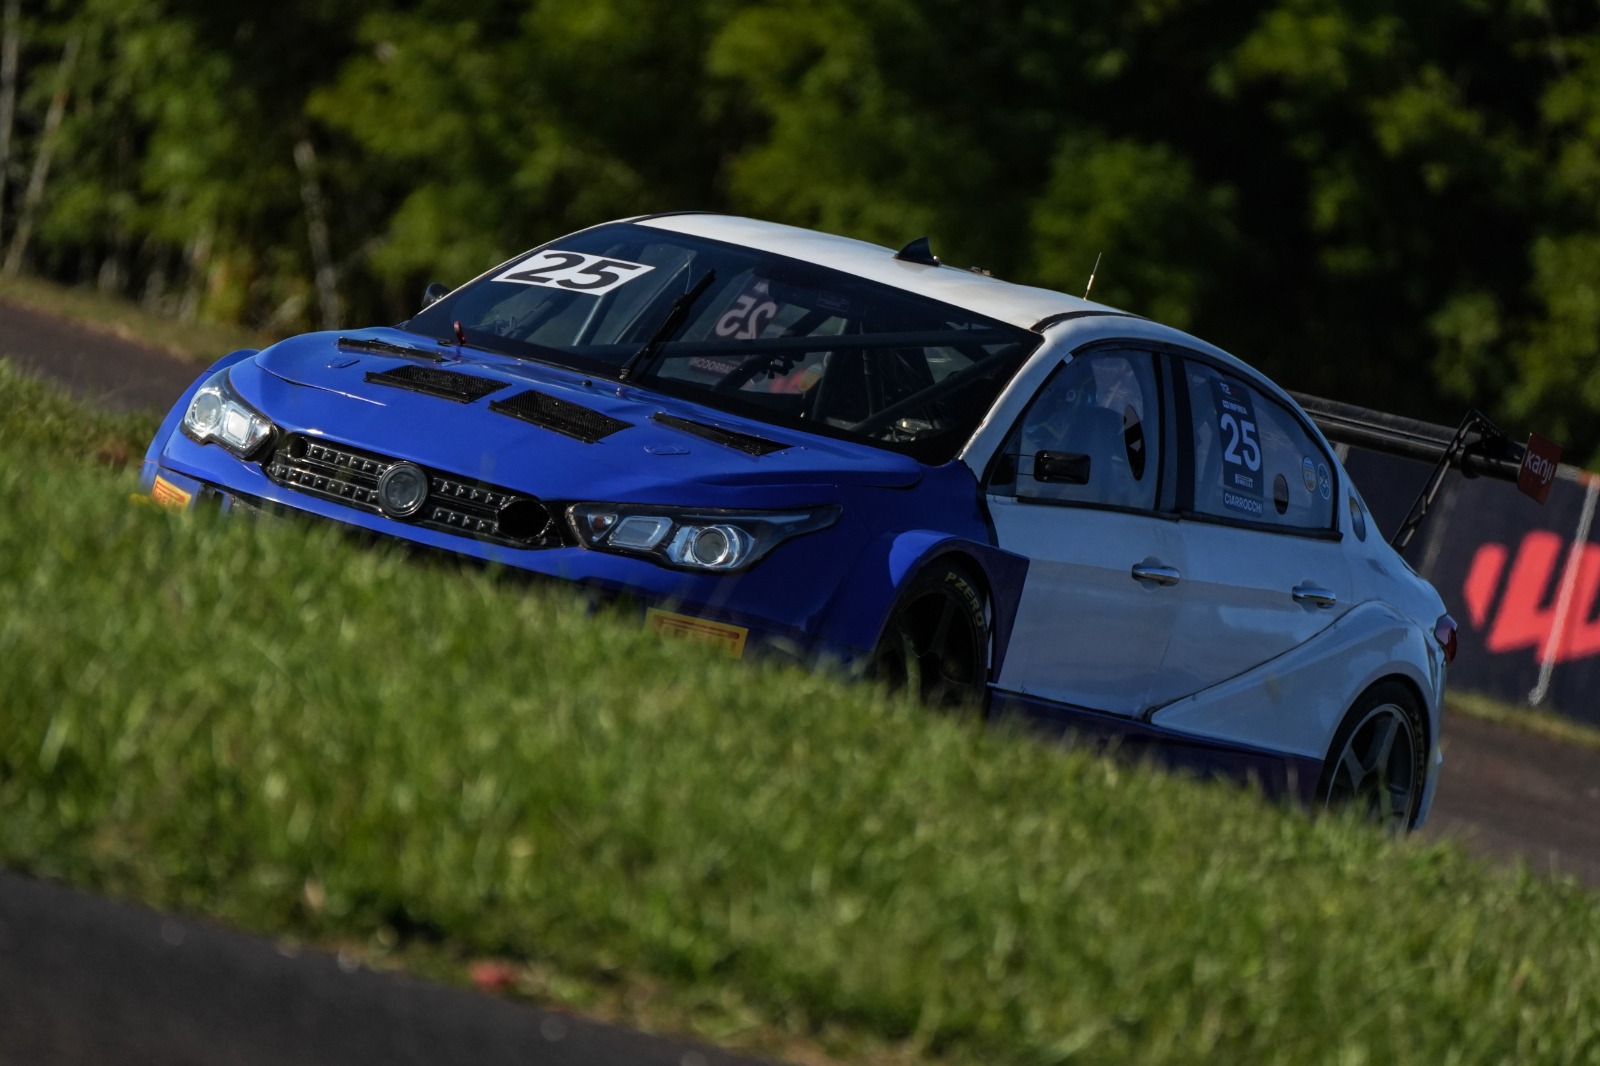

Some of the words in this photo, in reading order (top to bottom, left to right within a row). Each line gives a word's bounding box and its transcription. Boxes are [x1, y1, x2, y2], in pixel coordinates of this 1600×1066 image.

[503, 253, 642, 290] 25
[1220, 413, 1261, 471] 25
[1525, 450, 1555, 485] kanji
[1224, 492, 1263, 514] CIARROCCHI
